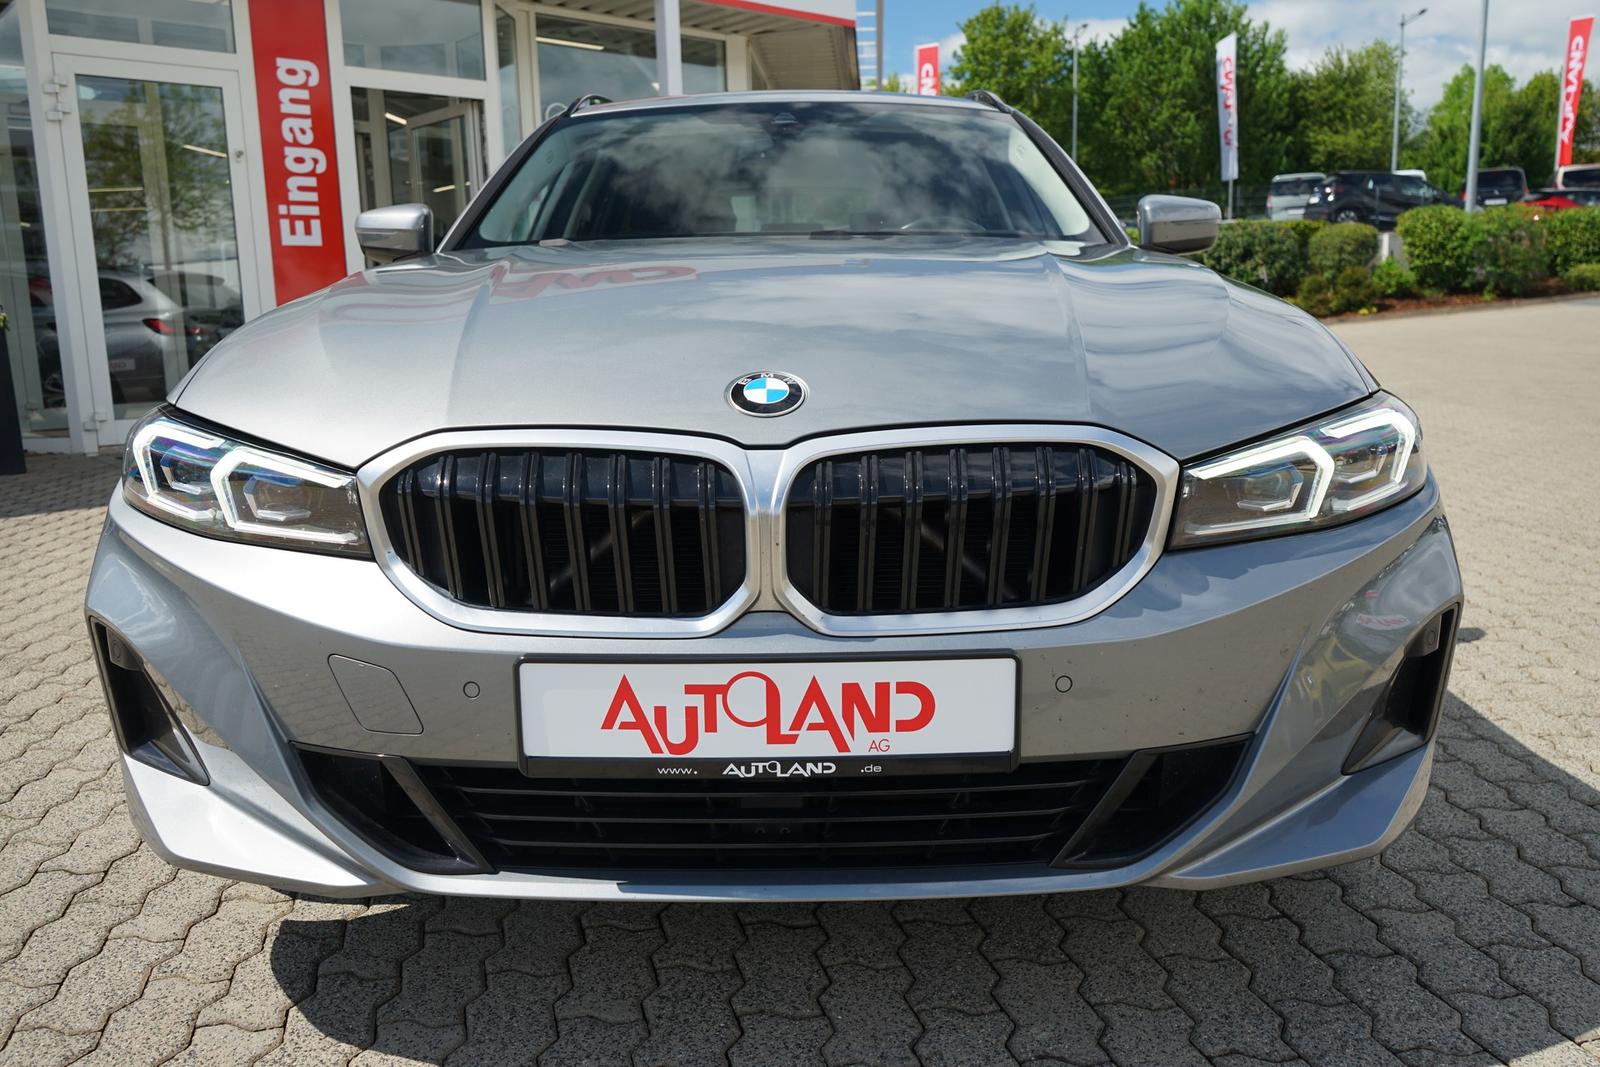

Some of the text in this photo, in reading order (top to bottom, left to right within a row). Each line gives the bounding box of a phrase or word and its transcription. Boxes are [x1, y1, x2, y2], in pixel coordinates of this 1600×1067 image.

[275, 56, 327, 247] Eingang
[600, 671, 936, 756] AUTOLAND
[657, 760, 882, 778] www. AUTOLAND .de
[868, 738, 891, 753] AG
